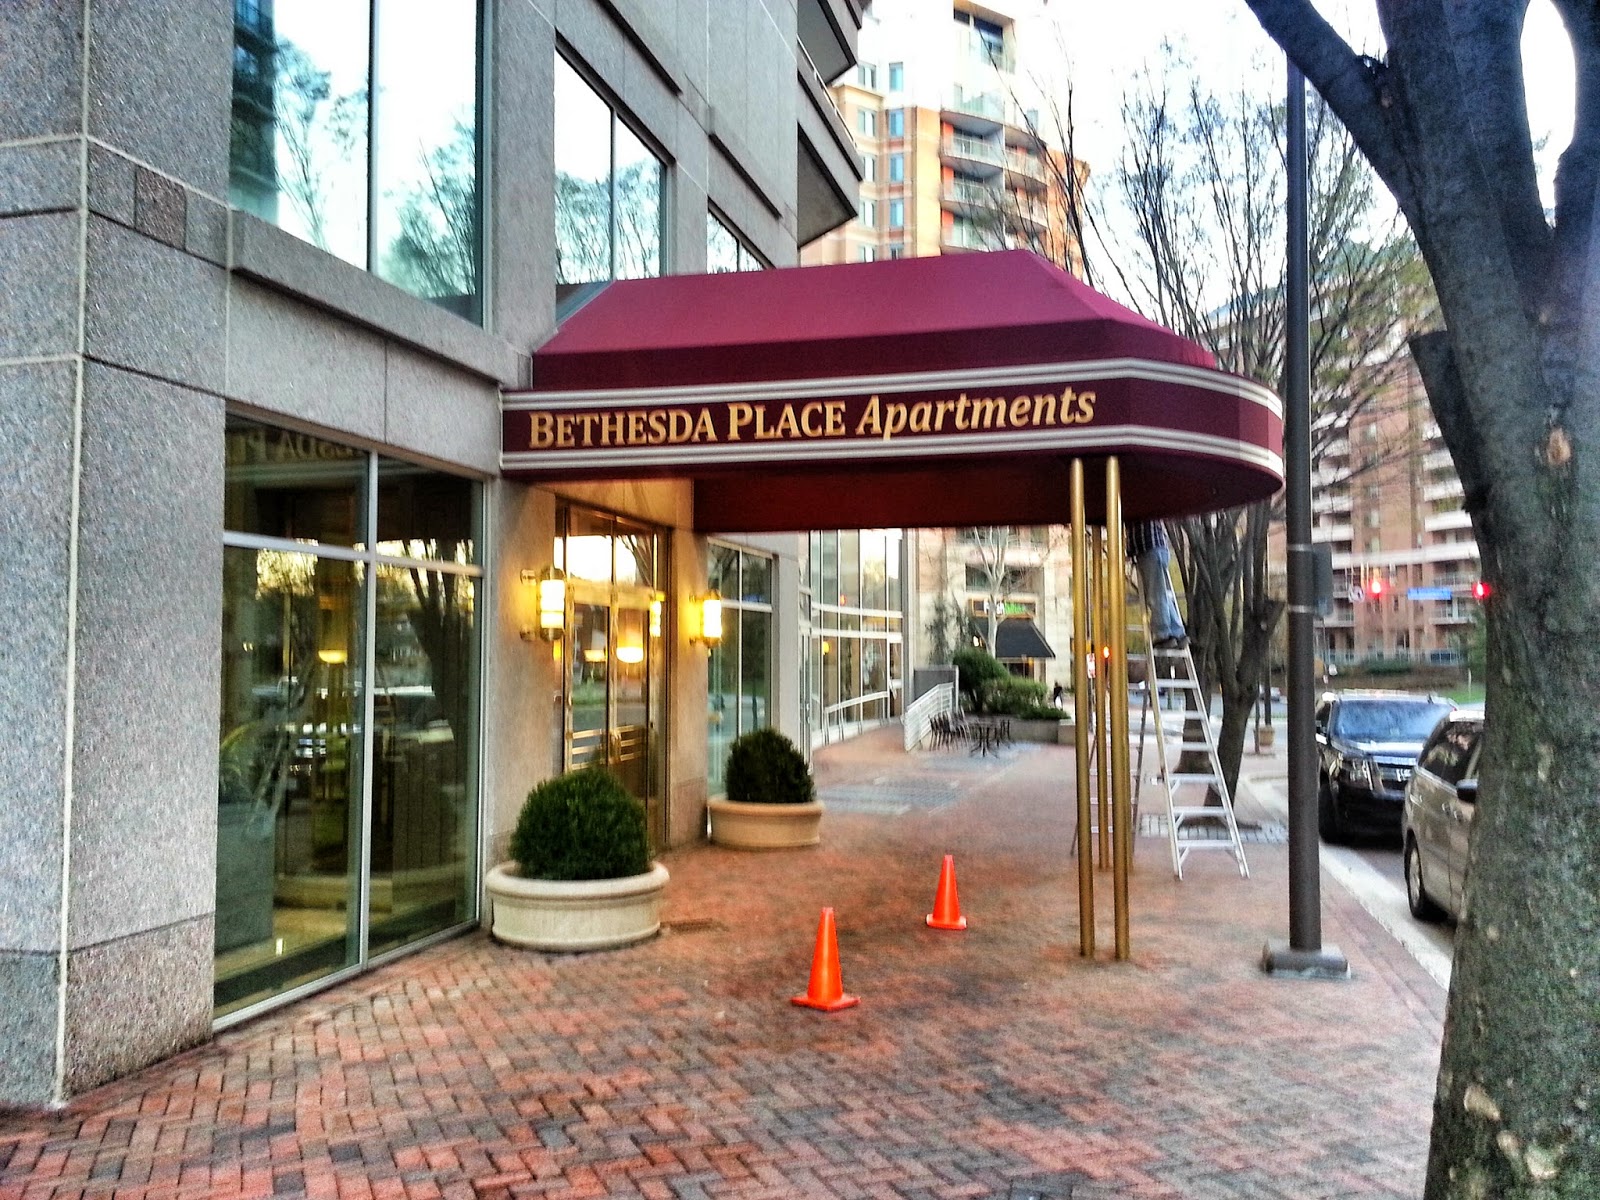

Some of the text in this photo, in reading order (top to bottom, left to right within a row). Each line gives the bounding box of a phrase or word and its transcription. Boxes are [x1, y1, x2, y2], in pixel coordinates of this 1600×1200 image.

[529, 386, 1096, 449] BETHESDA PLACE Apartments
